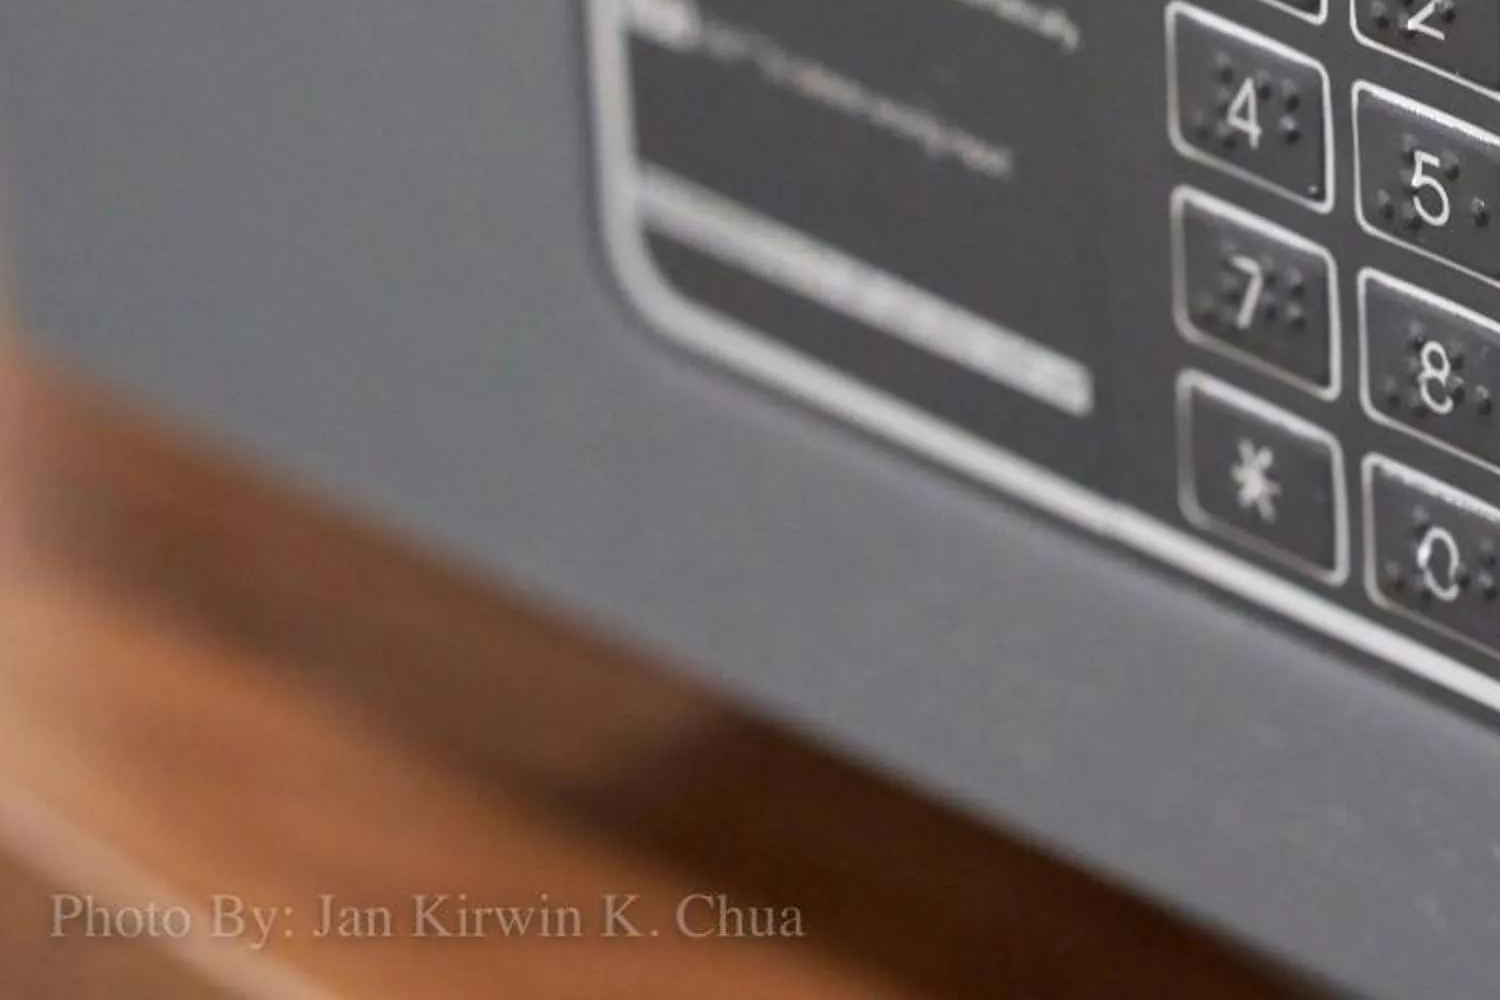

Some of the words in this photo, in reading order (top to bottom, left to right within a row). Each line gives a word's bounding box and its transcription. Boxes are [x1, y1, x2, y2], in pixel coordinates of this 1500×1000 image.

[1226, 76, 1263, 149] 4
[1410, 150, 1450, 227] 5
[1230, 254, 1263, 330] 7
[1419, 340, 1453, 415] 8
[1417, 525, 1460, 601] 0
